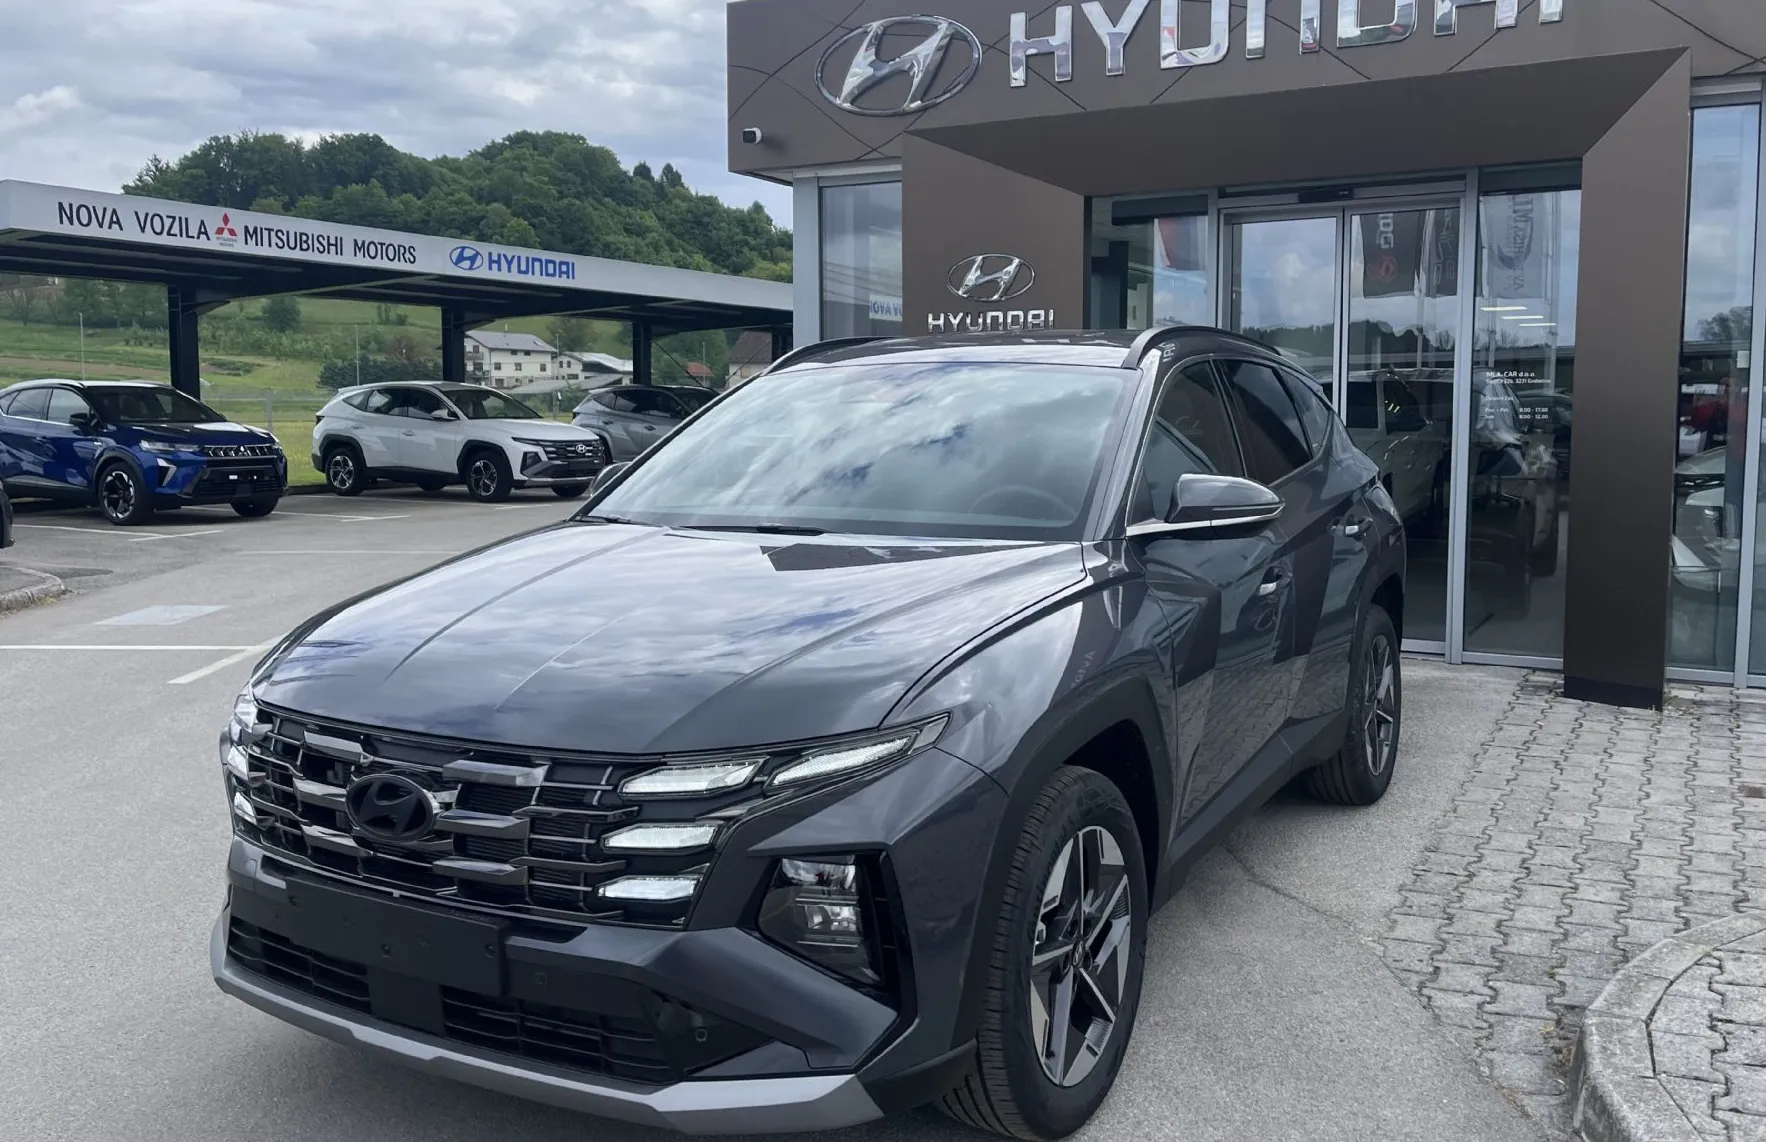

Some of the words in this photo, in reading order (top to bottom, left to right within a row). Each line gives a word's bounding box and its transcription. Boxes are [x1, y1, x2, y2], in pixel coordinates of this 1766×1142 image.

[1010, 0, 1562, 87] HYUND
[58, 201, 123, 231] NOVA
[134, 211, 211, 241] VOZILA
[243, 225, 343, 256] MITSUBISHI
[353, 239, 416, 264] MOTORS
[488, 251, 575, 280] HYUNDAI
[928, 309, 1054, 332] HYUNDAI
